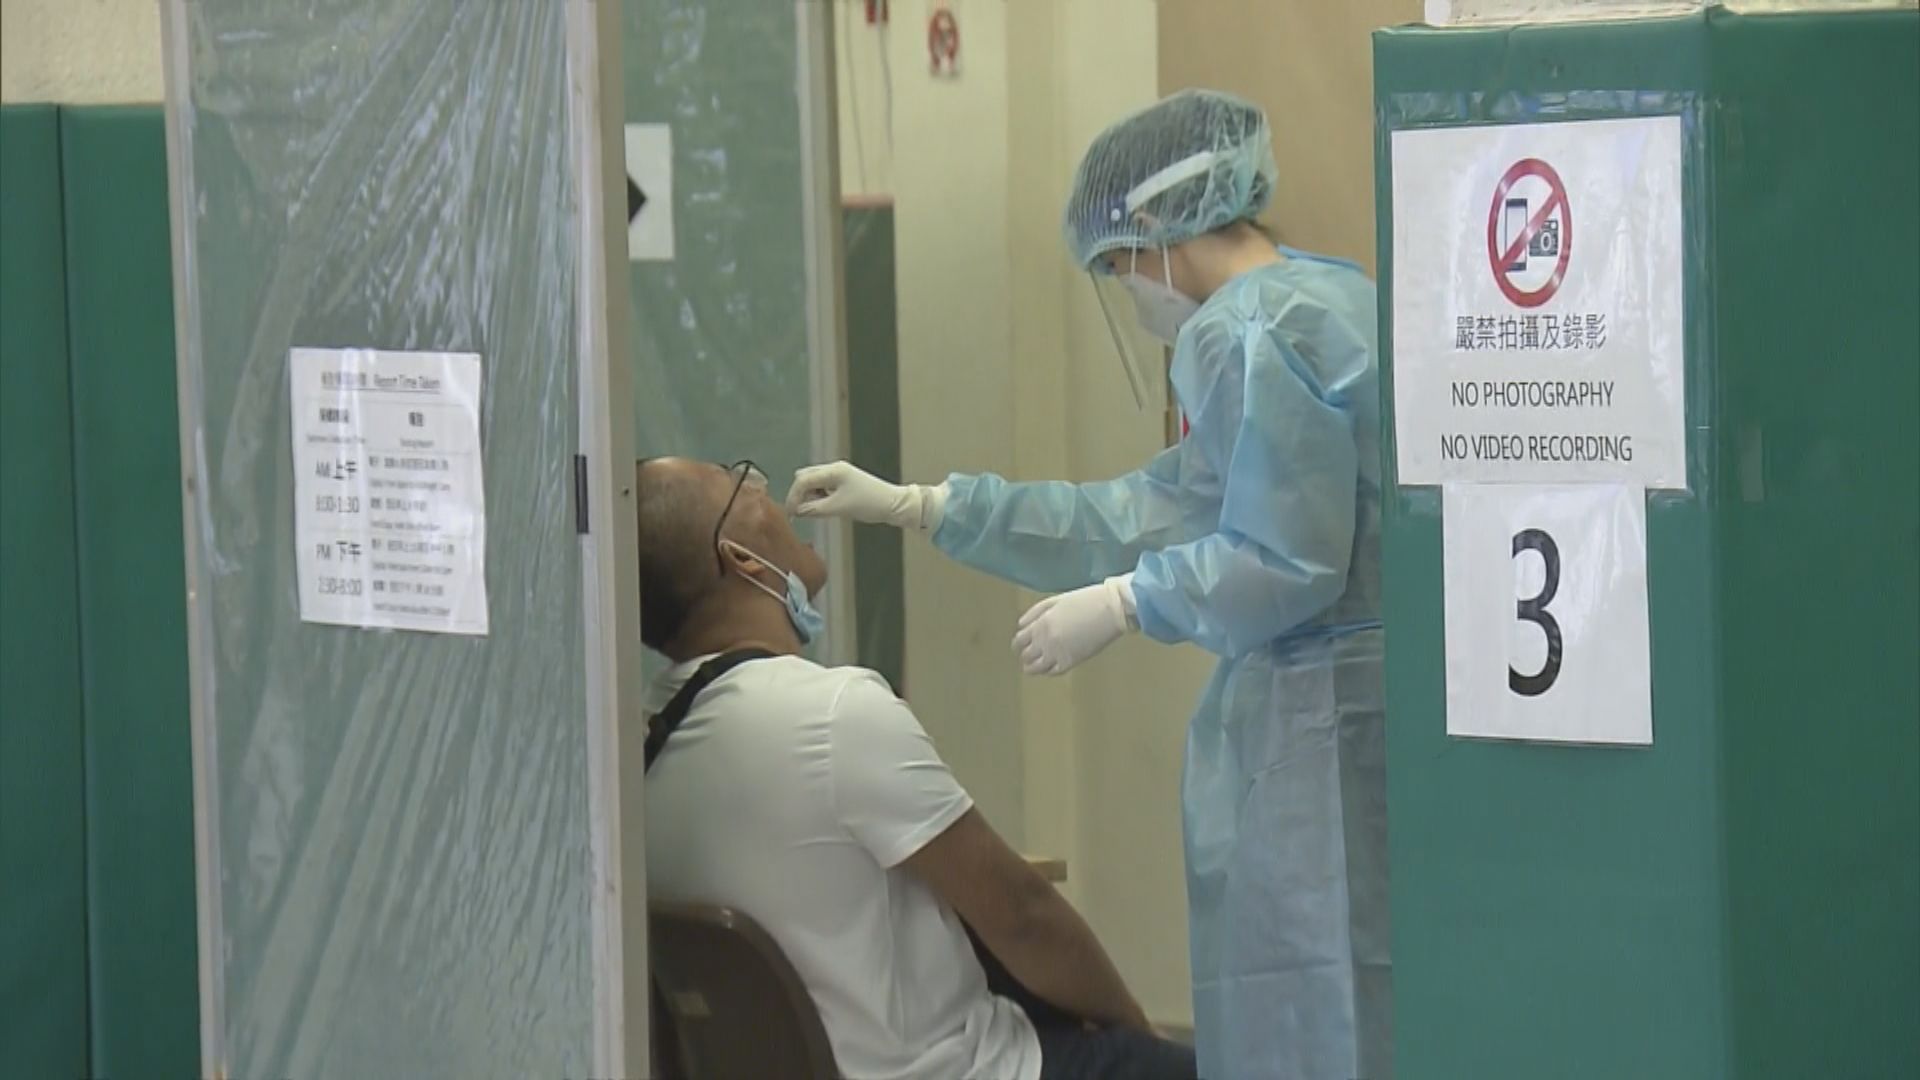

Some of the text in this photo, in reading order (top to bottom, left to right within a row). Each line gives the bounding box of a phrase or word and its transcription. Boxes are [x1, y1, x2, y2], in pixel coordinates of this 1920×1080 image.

[1455, 313, 1607, 350] 嚴禁拍攝及錄影
[1451, 381, 1614, 407] NO PHOTOGRAPHY
[1441, 434, 1632, 461] NO VIDEO RECORDING
[315, 460, 331, 478] AM
[332, 458, 357, 480] 上午
[316, 543, 332, 561] PM
[335, 540, 362, 563] 下午
[1508, 528, 1563, 697] 3
